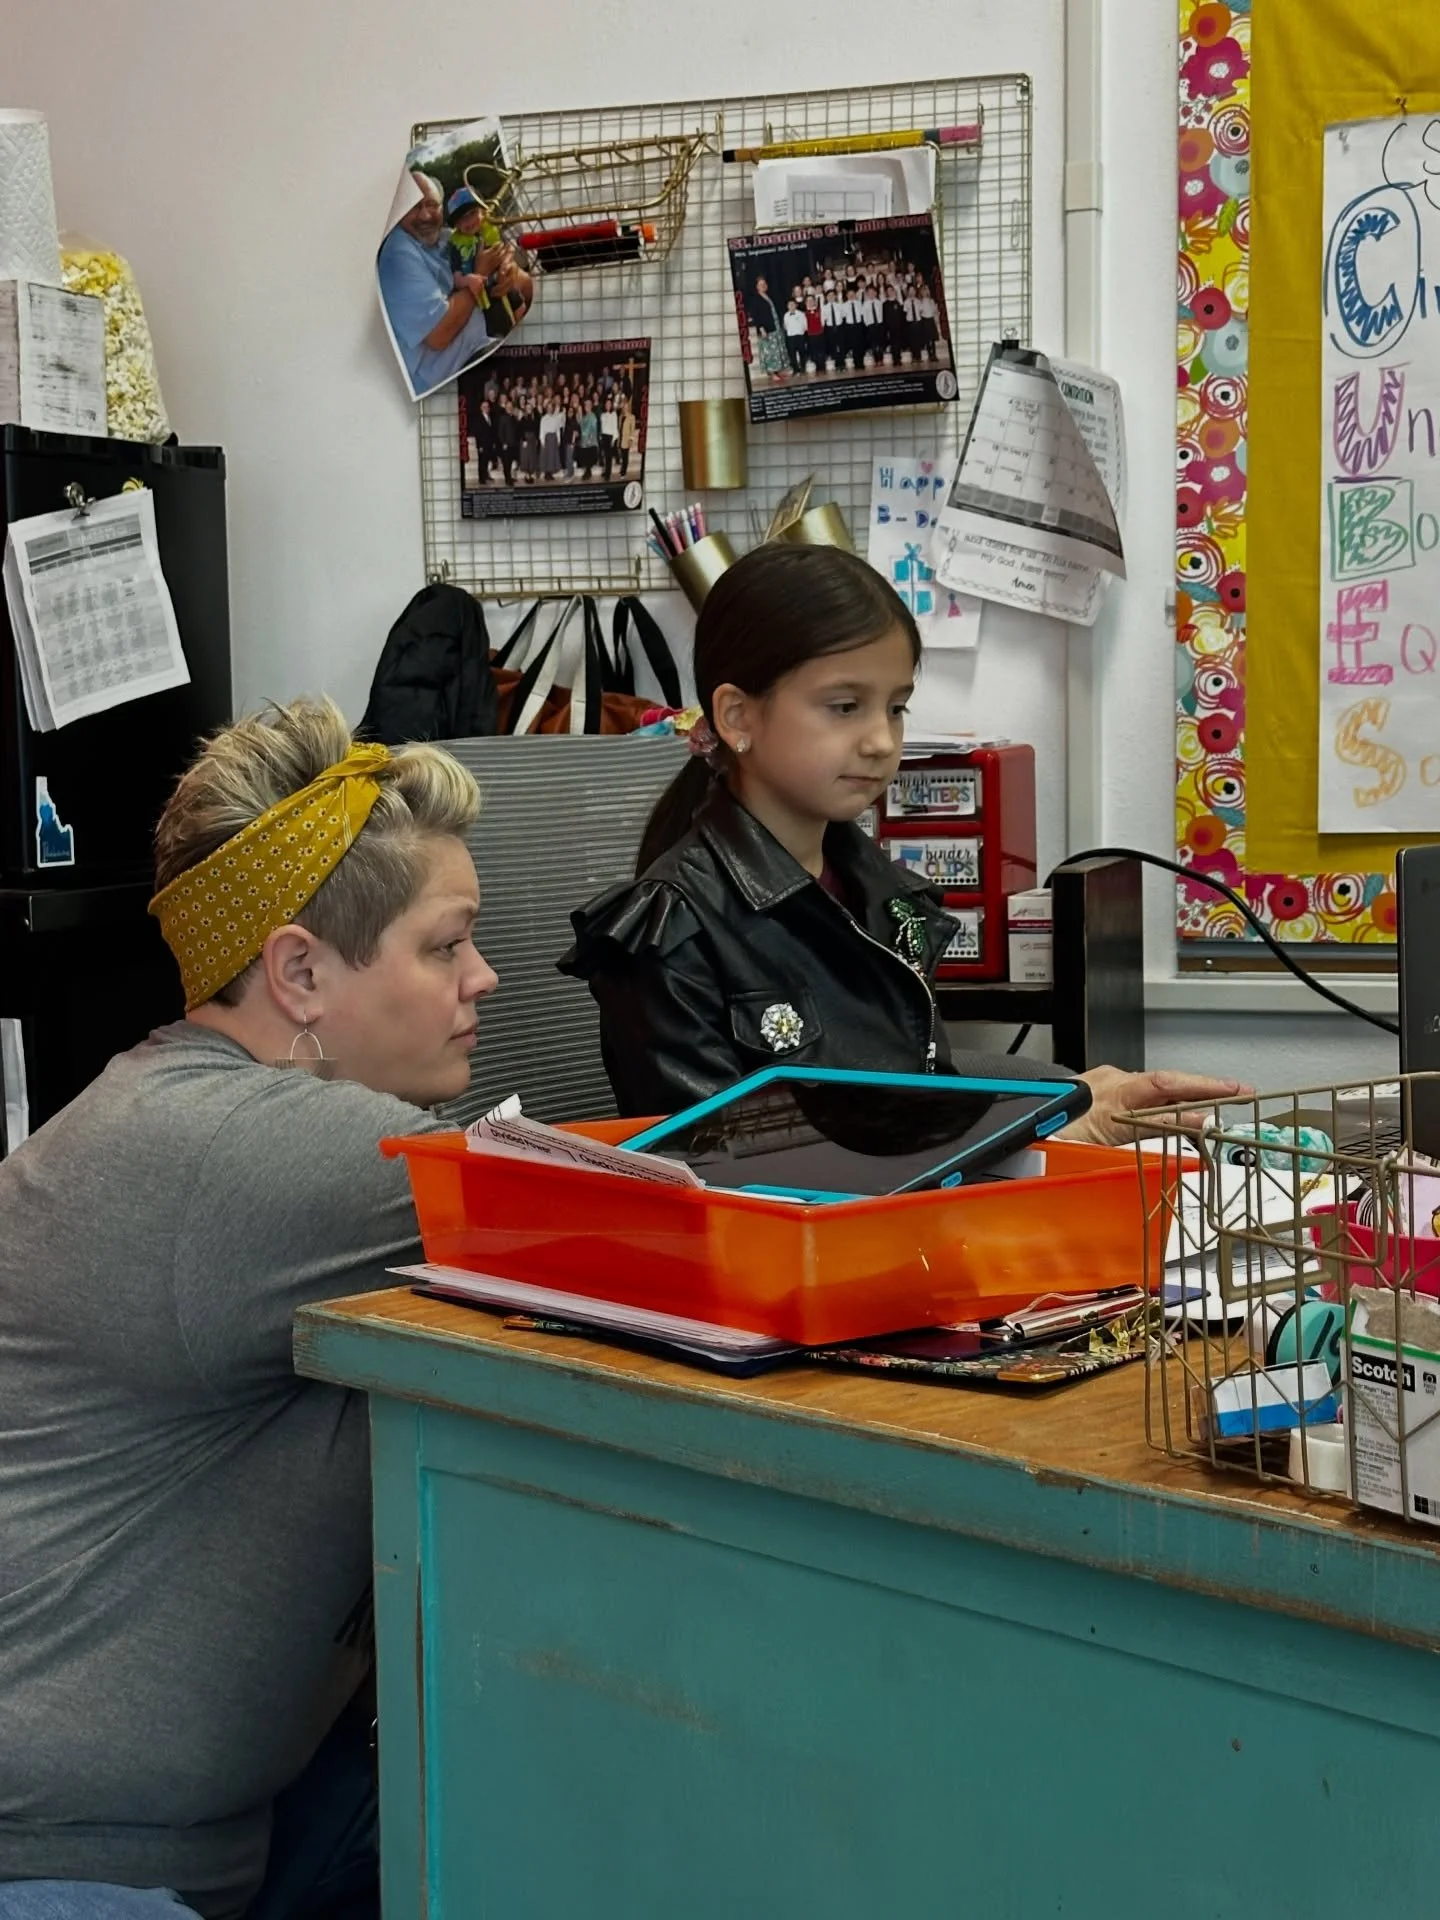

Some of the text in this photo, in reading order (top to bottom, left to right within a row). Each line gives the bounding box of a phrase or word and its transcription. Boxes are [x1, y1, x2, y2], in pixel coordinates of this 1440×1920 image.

[879, 466, 945, 501] Happ
[892, 787, 970, 804] LIGHTERS
[925, 843, 975, 863] binder
[925, 862, 975, 878] CLIPS
[1352, 1356, 1411, 1386] Scotch
